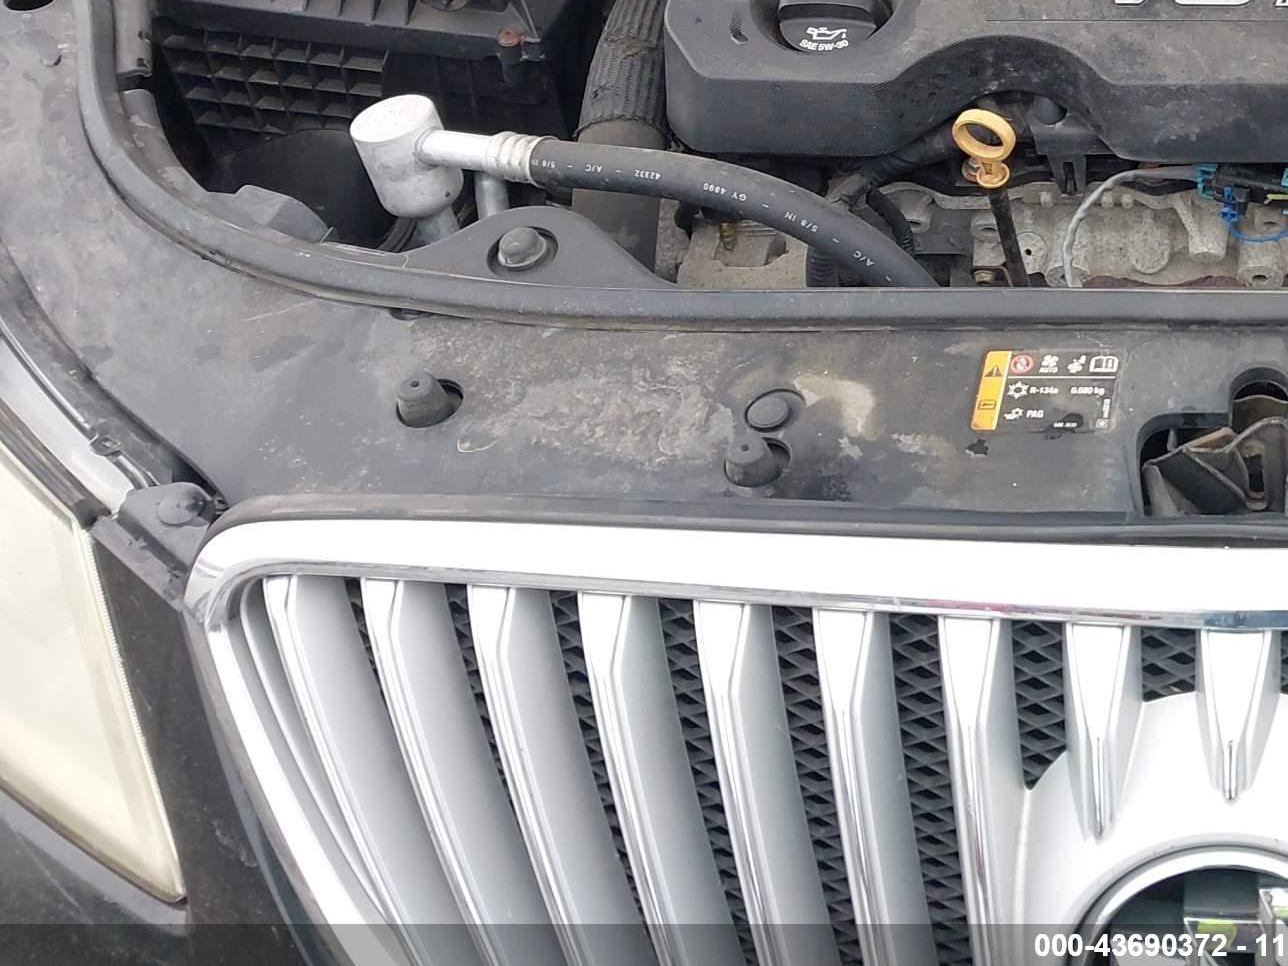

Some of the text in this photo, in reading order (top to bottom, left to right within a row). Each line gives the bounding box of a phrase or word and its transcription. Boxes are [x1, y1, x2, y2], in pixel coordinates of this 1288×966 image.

[799, 39, 819, 51] SAE
[584, 163, 603, 173] A/C
[633, 168, 662, 181] 42332
[731, 190, 747, 202] GY
[784, 210, 799, 222] IN
[800, 218, 819, 233] 5/8
[852, 249, 875, 267] A/C
[1029, 386, 1059, 395] R-134a
[1093, 386, 1105, 396] kg
